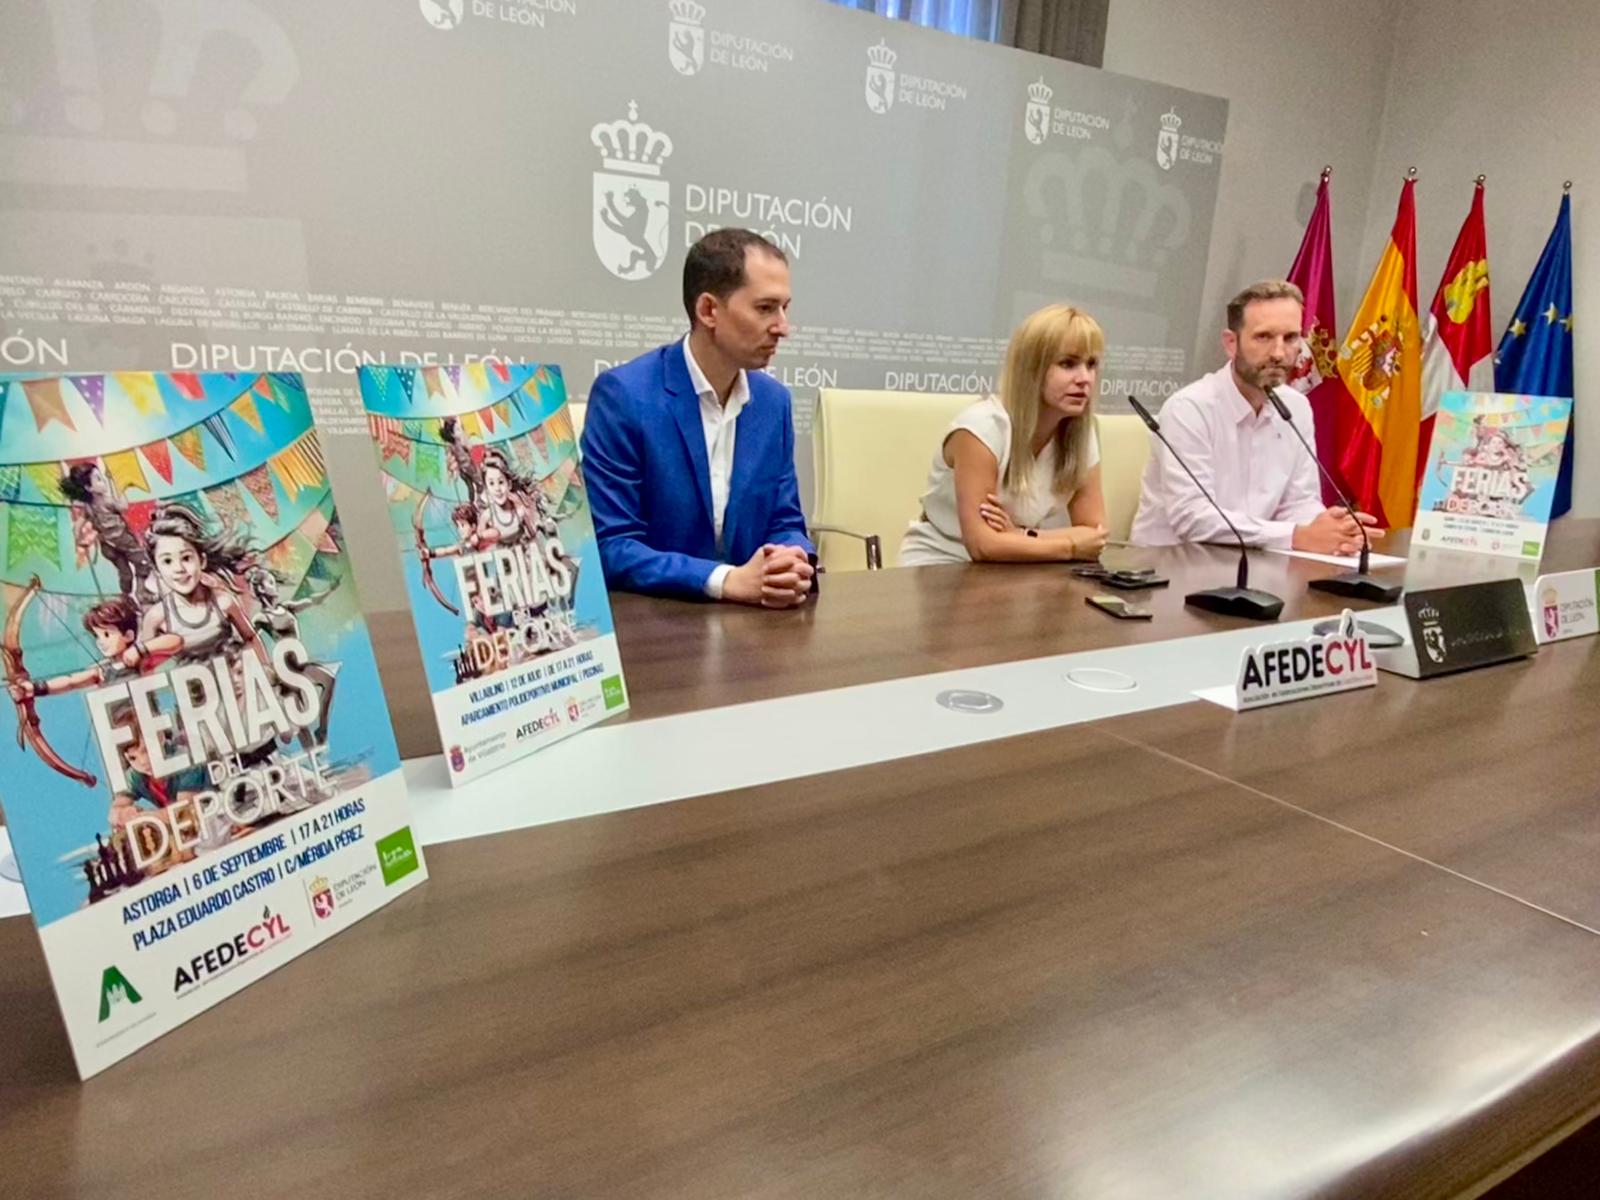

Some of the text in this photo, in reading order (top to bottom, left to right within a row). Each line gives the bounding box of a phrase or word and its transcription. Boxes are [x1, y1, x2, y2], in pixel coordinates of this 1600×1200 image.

[472, 0, 495, 18] DE
[500, 3, 545, 28] LEÓN
[710, 48, 769, 74] DE LEÓN
[711, 30, 794, 62] DIPUTACIÓN
[900, 90, 947, 111] DE LEÓN
[901, 75, 967, 101] DIPUTACIÓN
[1052, 121, 1067, 136] DE
[1054, 106, 1111, 130] DIPUTACIÓN
[685, 184, 852, 232] DIPUTACIÓN
[171, 341, 386, 374] DIPUTACIÓN
[783, 363, 838, 388] LEÓN
[885, 369, 993, 393] DIPUTACIÓN
[1450, 466, 1529, 503] FERIAS
[454, 538, 571, 625] FERIAS
[1241, 638, 1372, 691] AFEDECYL
[86, 636, 322, 793] FERIAS
[515, 711, 561, 740] AFEDECYL
[125, 745, 338, 871] DEPORTE
[121, 798, 366, 925] ASTORGA 6 DE SEPTIEMBRE 17 A 21 HORAS
[132, 921, 178, 952] PLAZA
[176, 890, 233, 934] EDUARDO
[232, 867, 276, 902] CASTRO
[335, 823, 366, 851] PÉREZ
[173, 913, 291, 993] AFEDECYL
